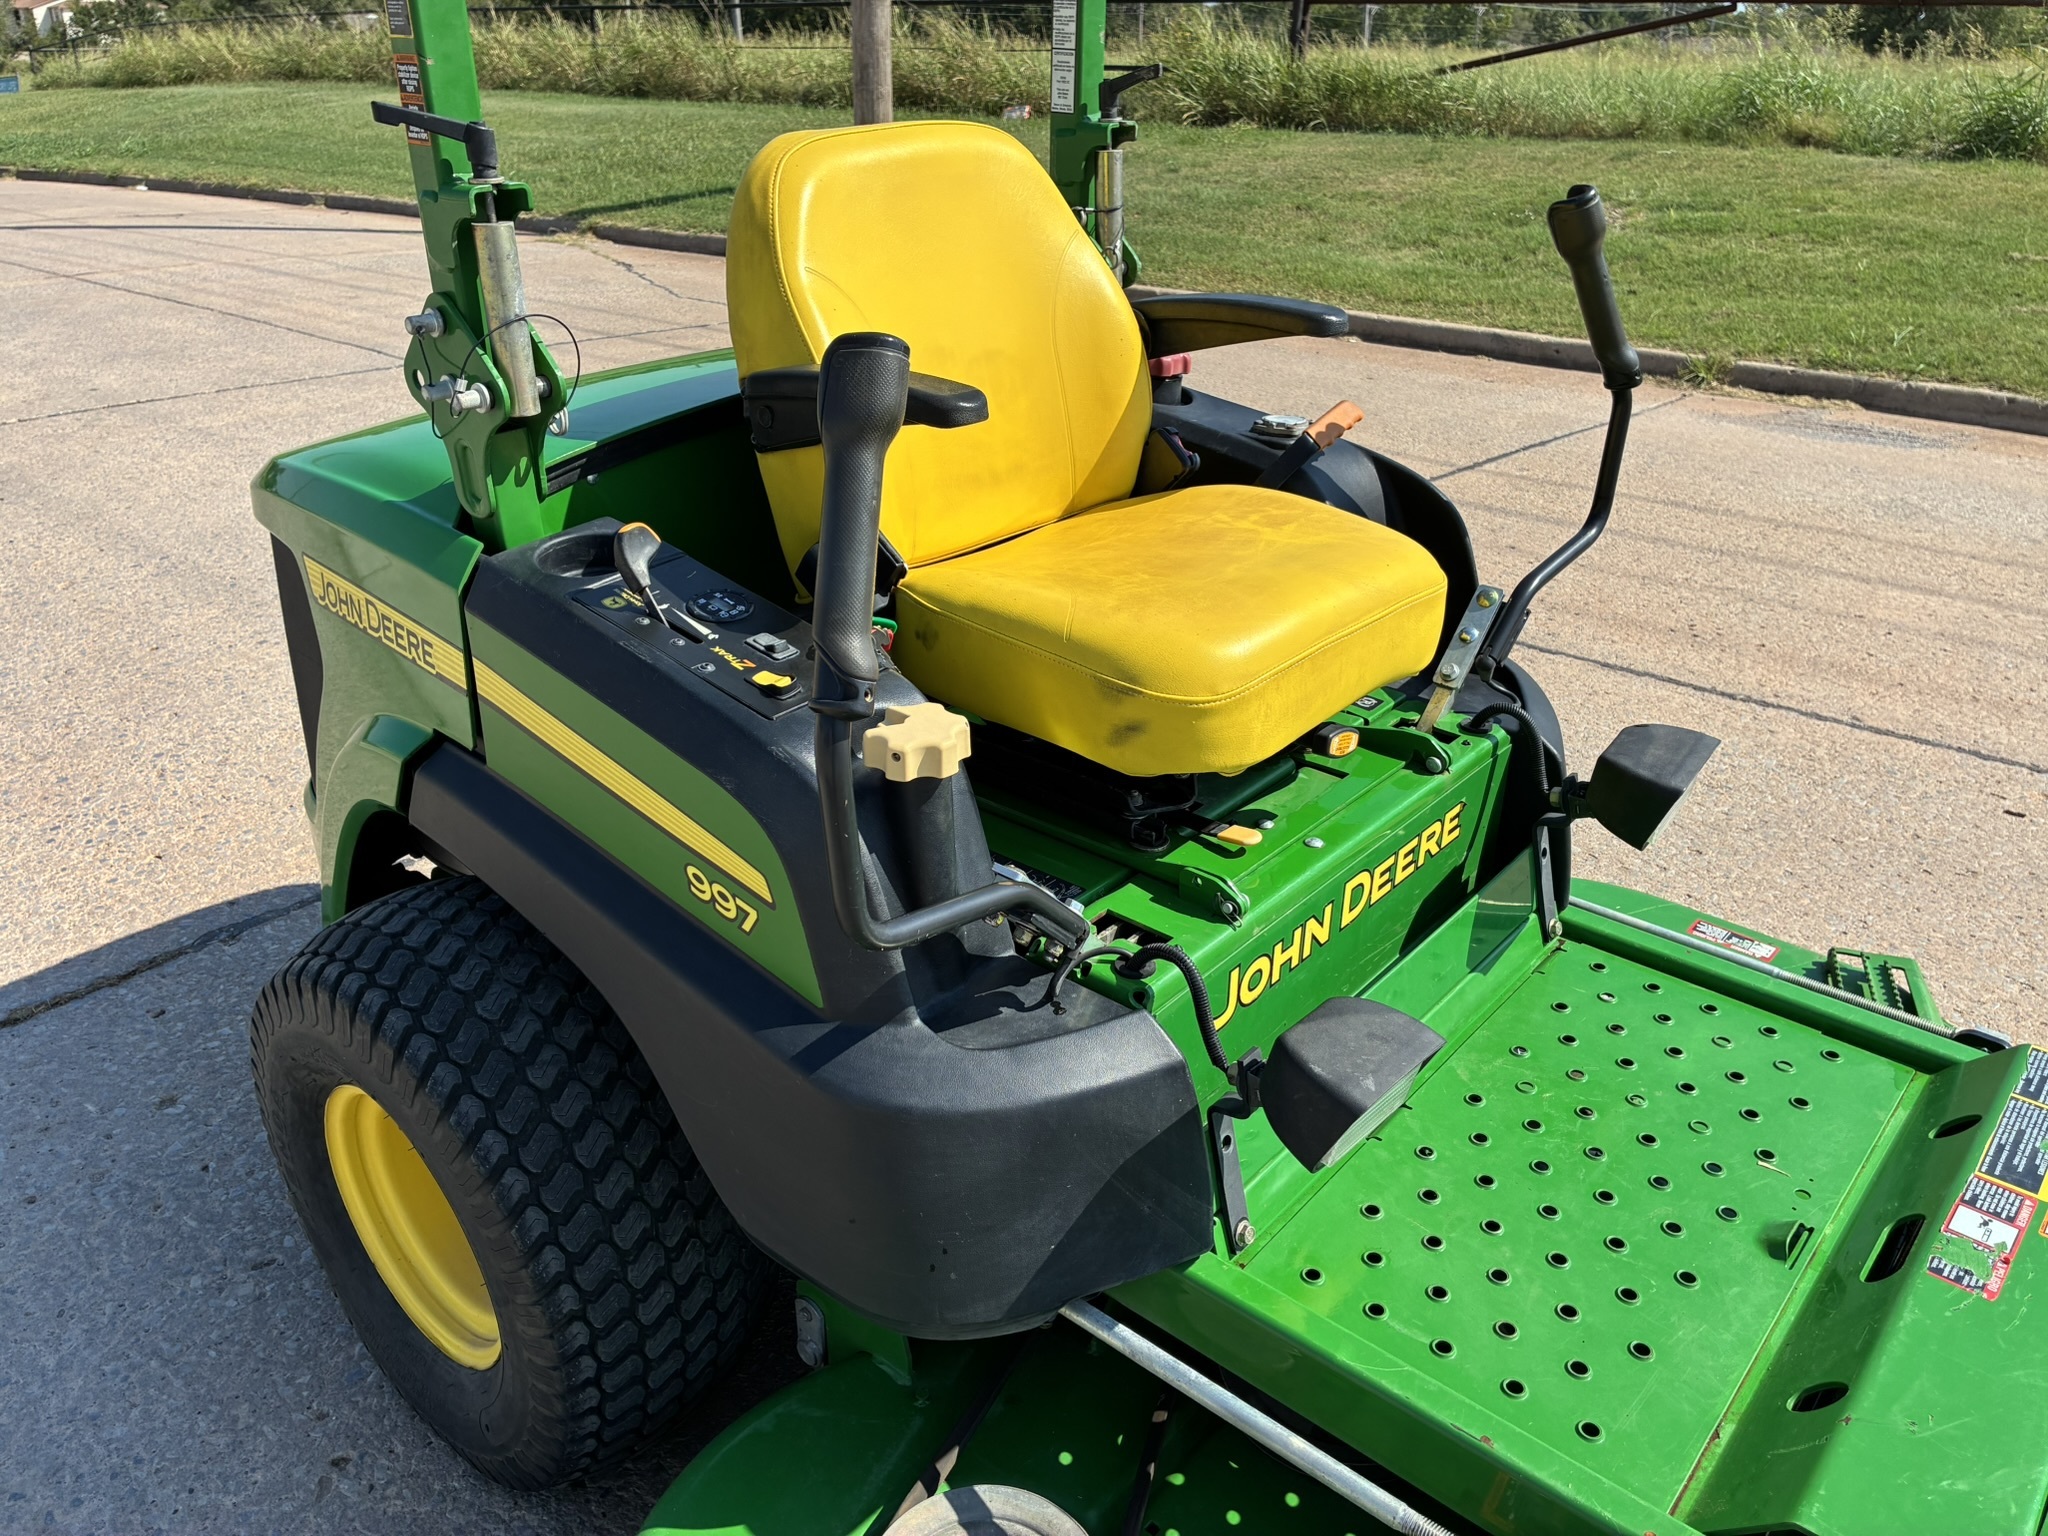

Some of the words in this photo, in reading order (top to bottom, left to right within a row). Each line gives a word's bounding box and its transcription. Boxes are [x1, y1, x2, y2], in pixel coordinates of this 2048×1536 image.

[318, 572, 363, 627] JOHN
[365, 597, 437, 671] DEERE
[685, 863, 759, 934] 997
[1213, 901, 1335, 1031] JOHN
[1339, 800, 1466, 931] DEERE
